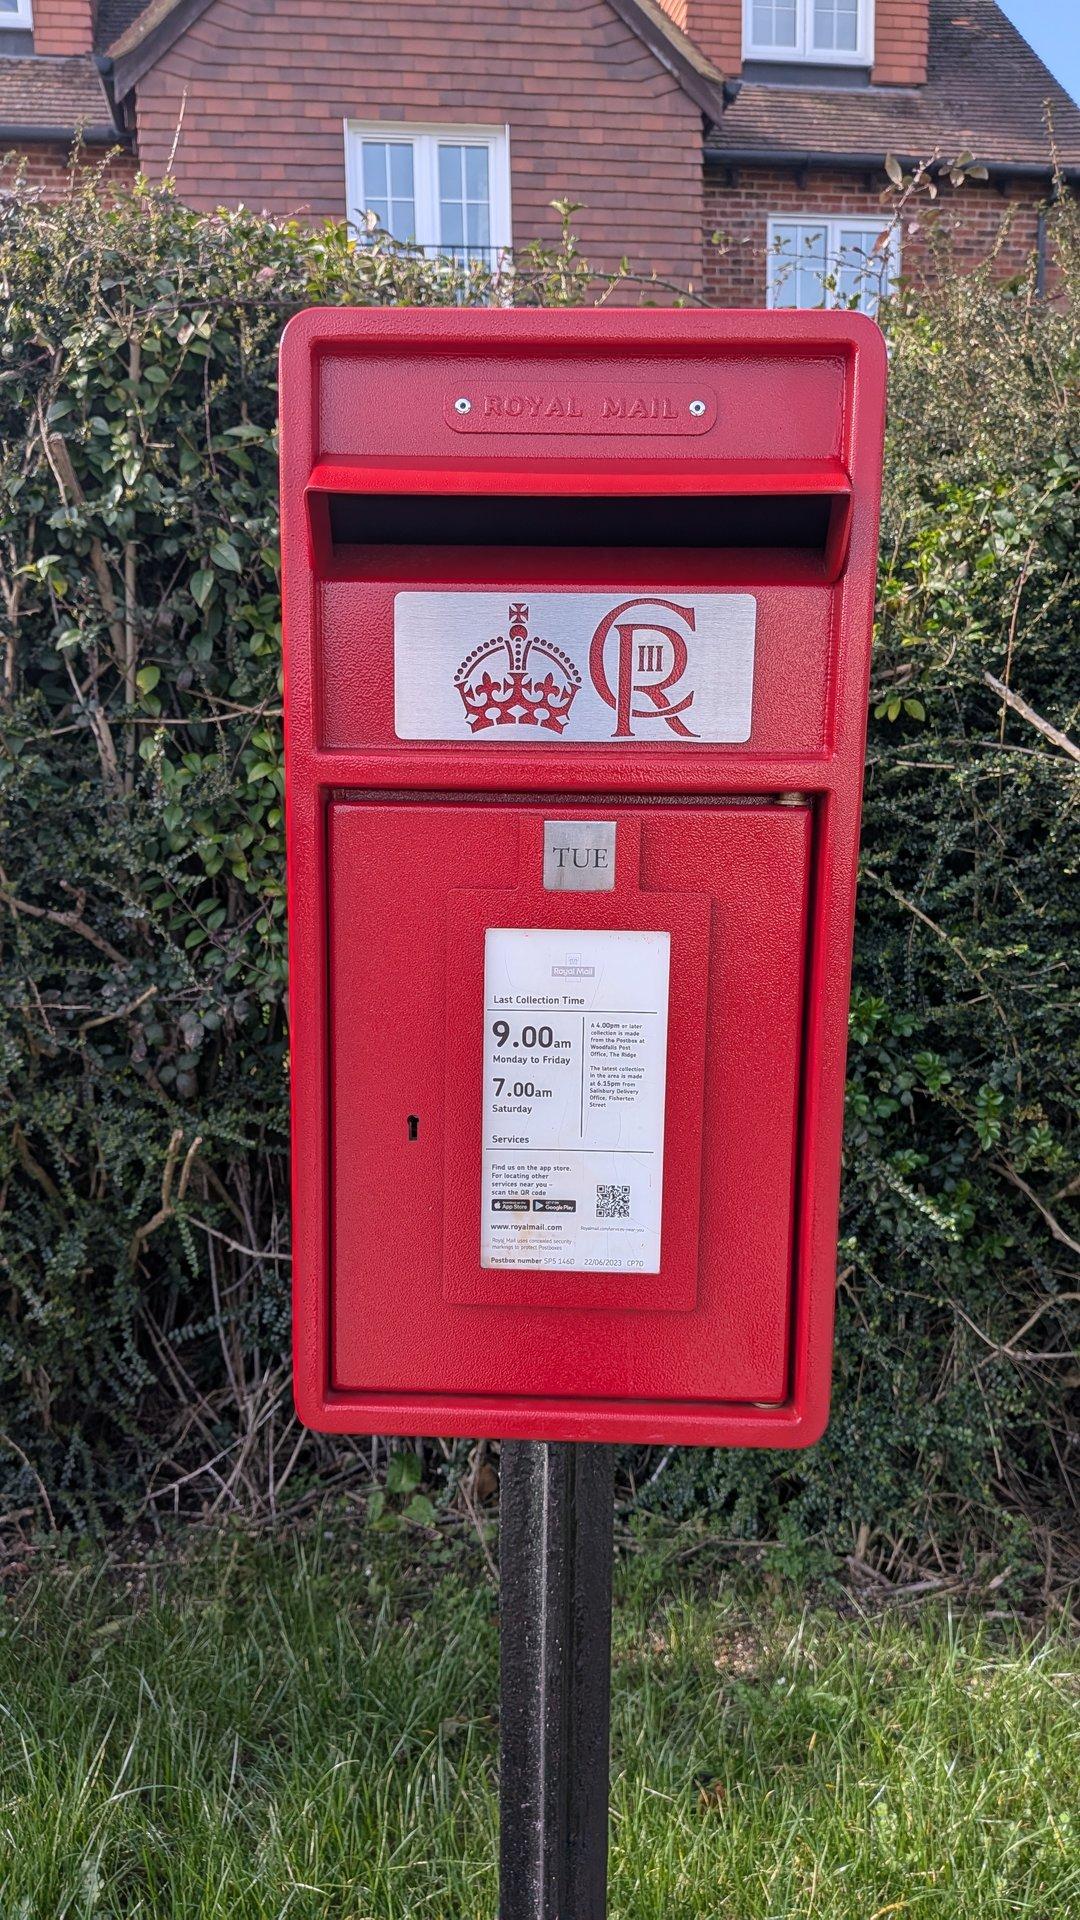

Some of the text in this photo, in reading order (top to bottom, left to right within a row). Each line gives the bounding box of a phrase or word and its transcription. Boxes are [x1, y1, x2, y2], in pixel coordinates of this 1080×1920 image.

[484, 395, 678, 419] ROYAL MAIL
[553, 847, 608, 868] TUE
[494, 996, 584, 1005] Last Collection Time
[493, 1056, 527, 1064] Monday
[543, 1056, 570, 1065] Friday
[492, 1105, 532, 1113] Saturday
